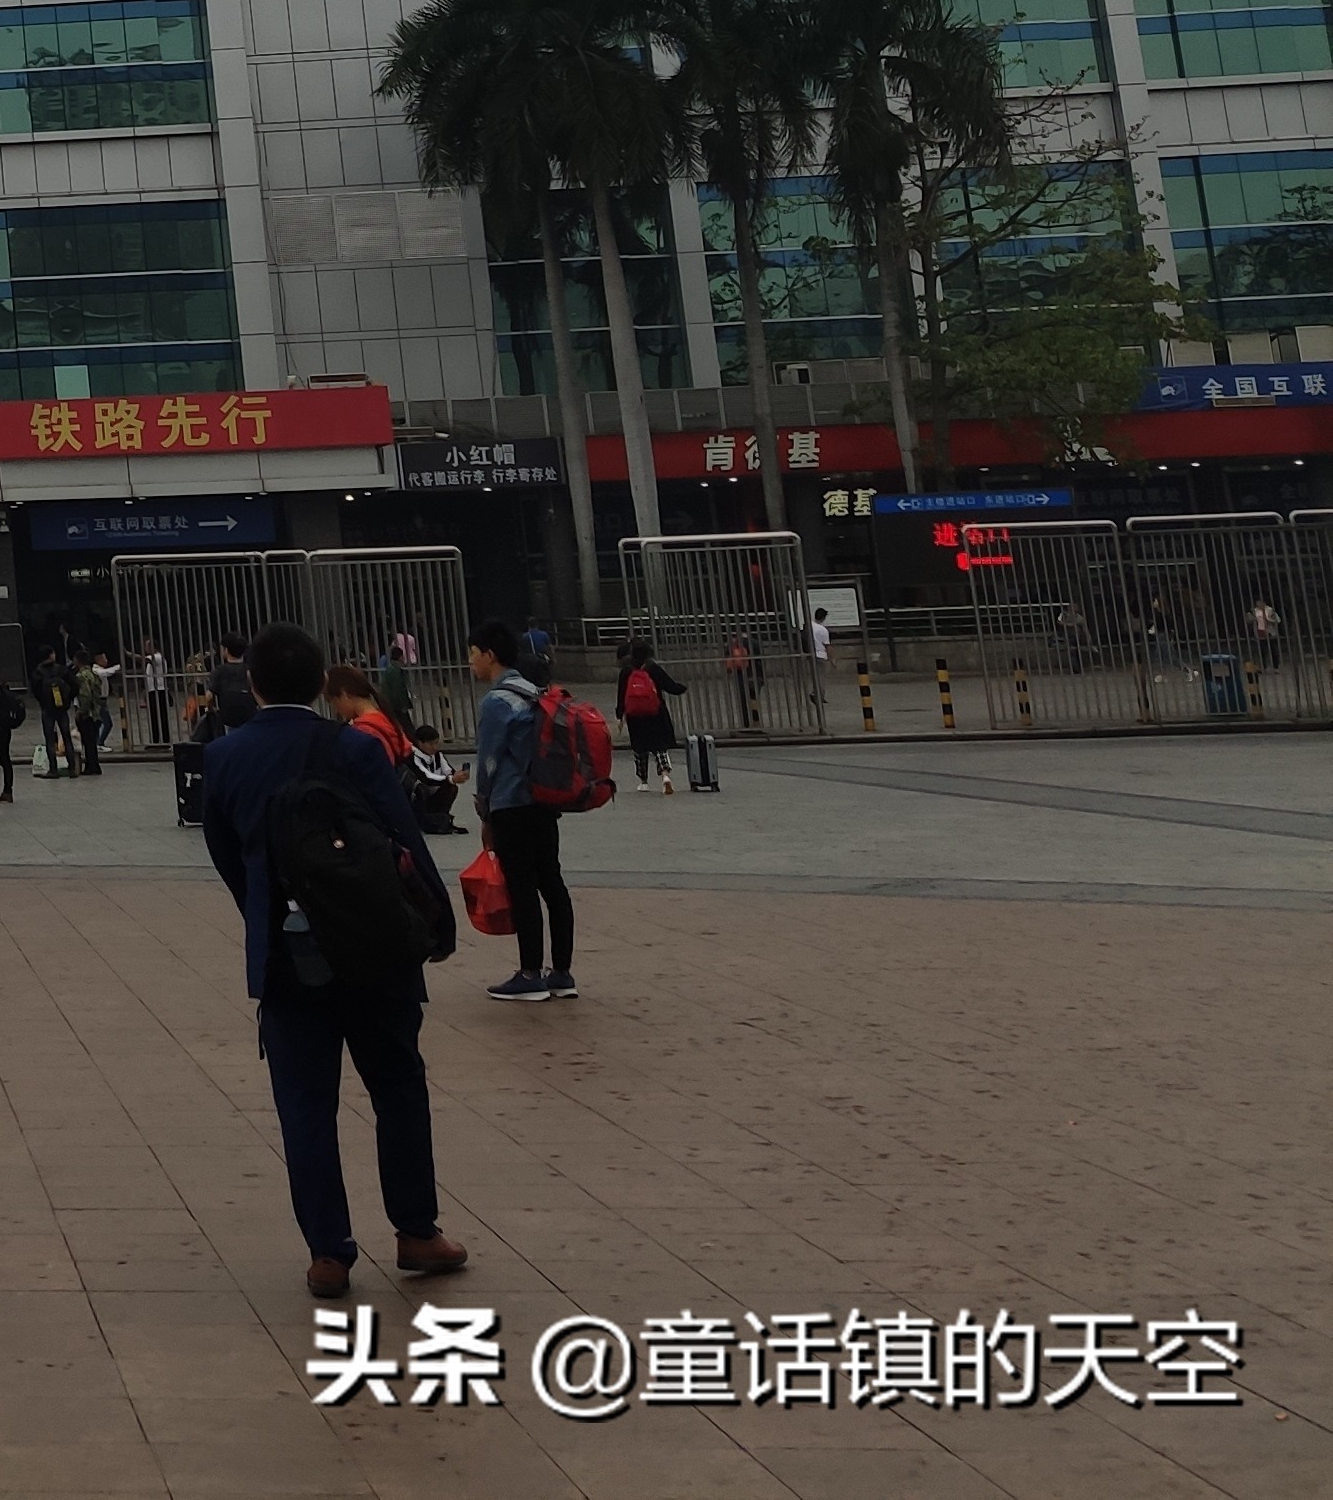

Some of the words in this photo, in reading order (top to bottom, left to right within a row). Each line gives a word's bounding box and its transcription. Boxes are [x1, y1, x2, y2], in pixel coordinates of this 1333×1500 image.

[1201, 373, 1327, 399] 全国互联
[30, 395, 273, 453] 铁路先行
[445, 443, 516, 468] 小红帽
